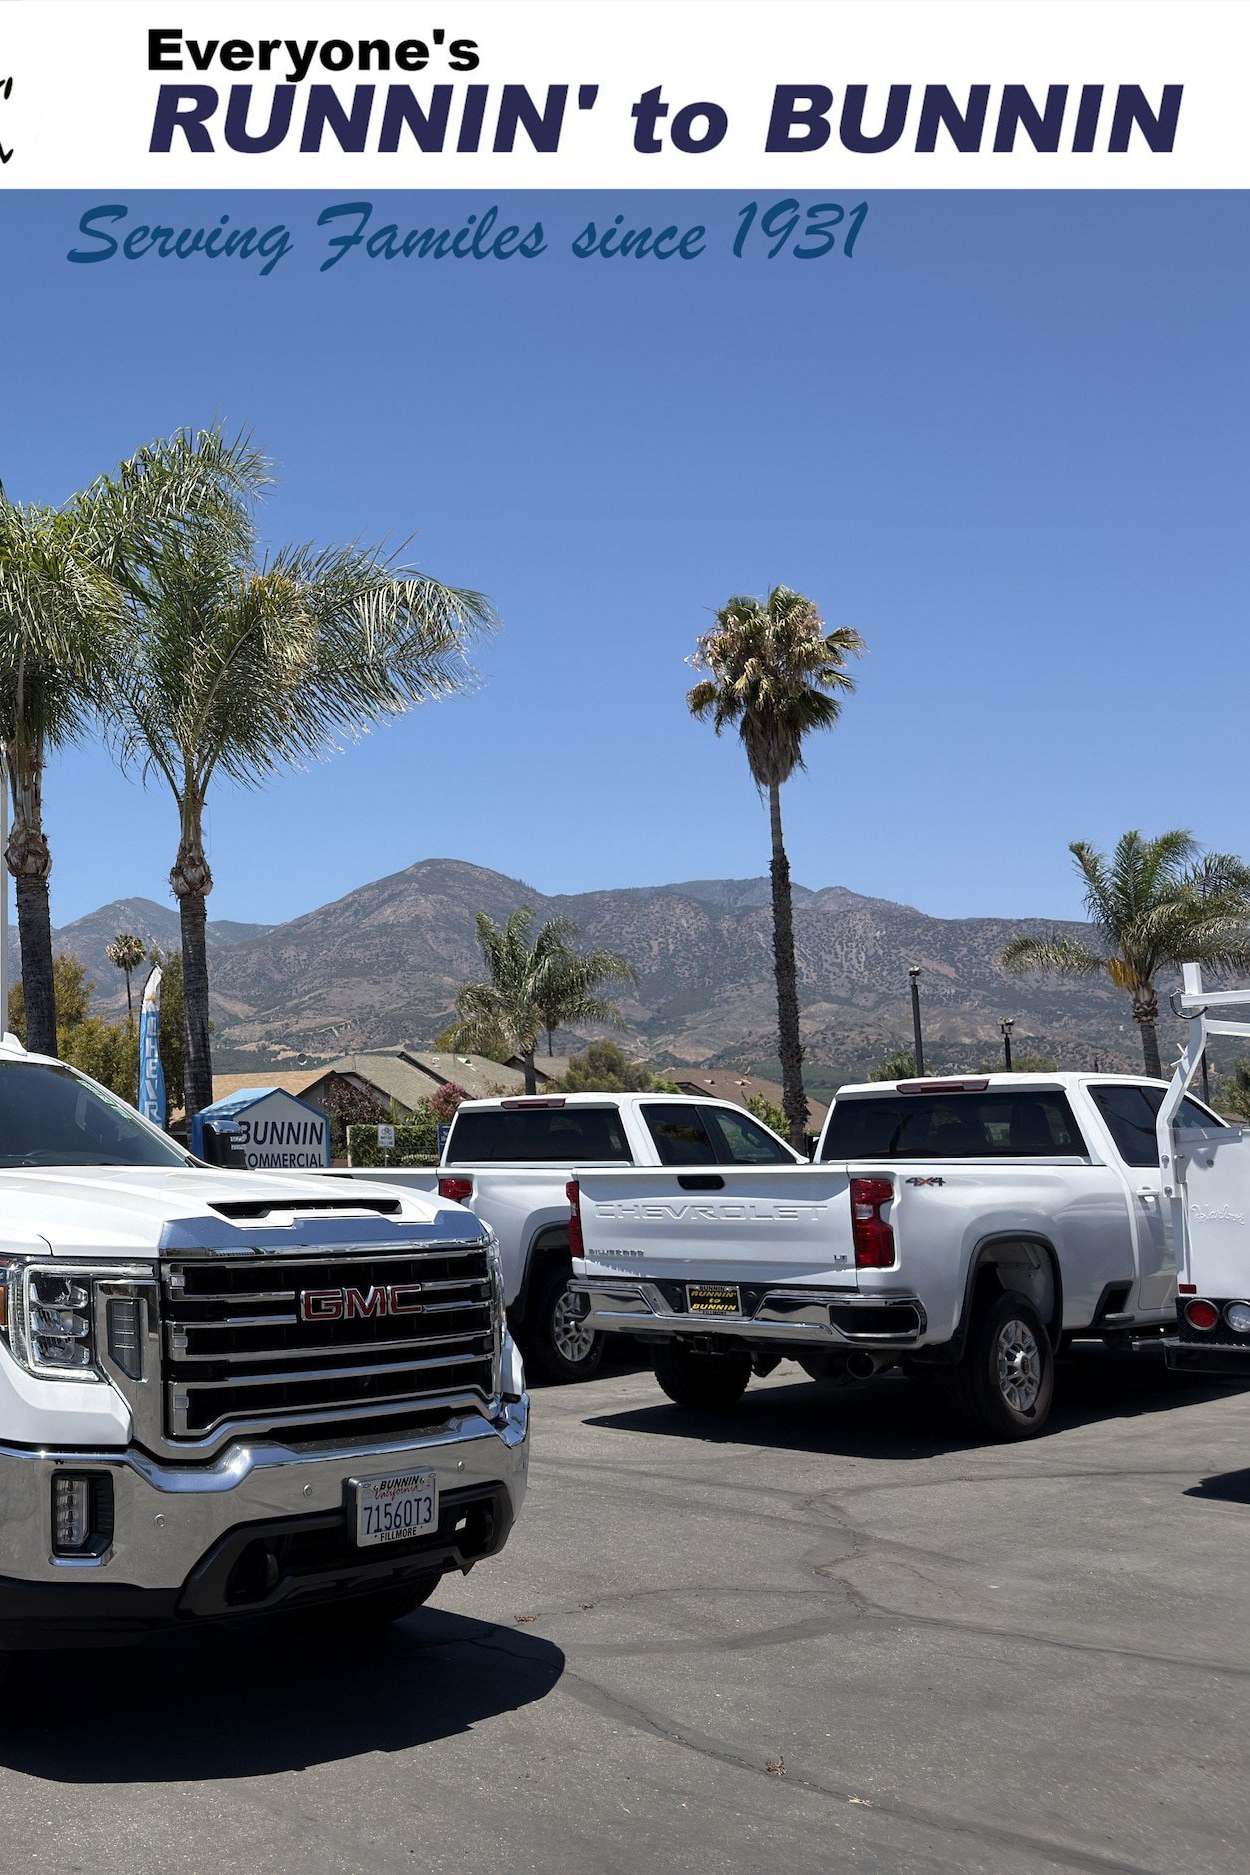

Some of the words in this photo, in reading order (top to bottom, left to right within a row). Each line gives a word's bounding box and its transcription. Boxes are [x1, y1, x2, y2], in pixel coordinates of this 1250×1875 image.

[245, 1153, 324, 1168] OMMERCIAL
[595, 1204, 829, 1221] CHEVROLET
[300, 1284, 423, 1321] GMC
[692, 1303, 737, 1311] BUNNIN
[379, 1475, 420, 1491] BUNNIN
[363, 1496, 432, 1535] 71560T3
[380, 1526, 418, 1542] FILLMORE
